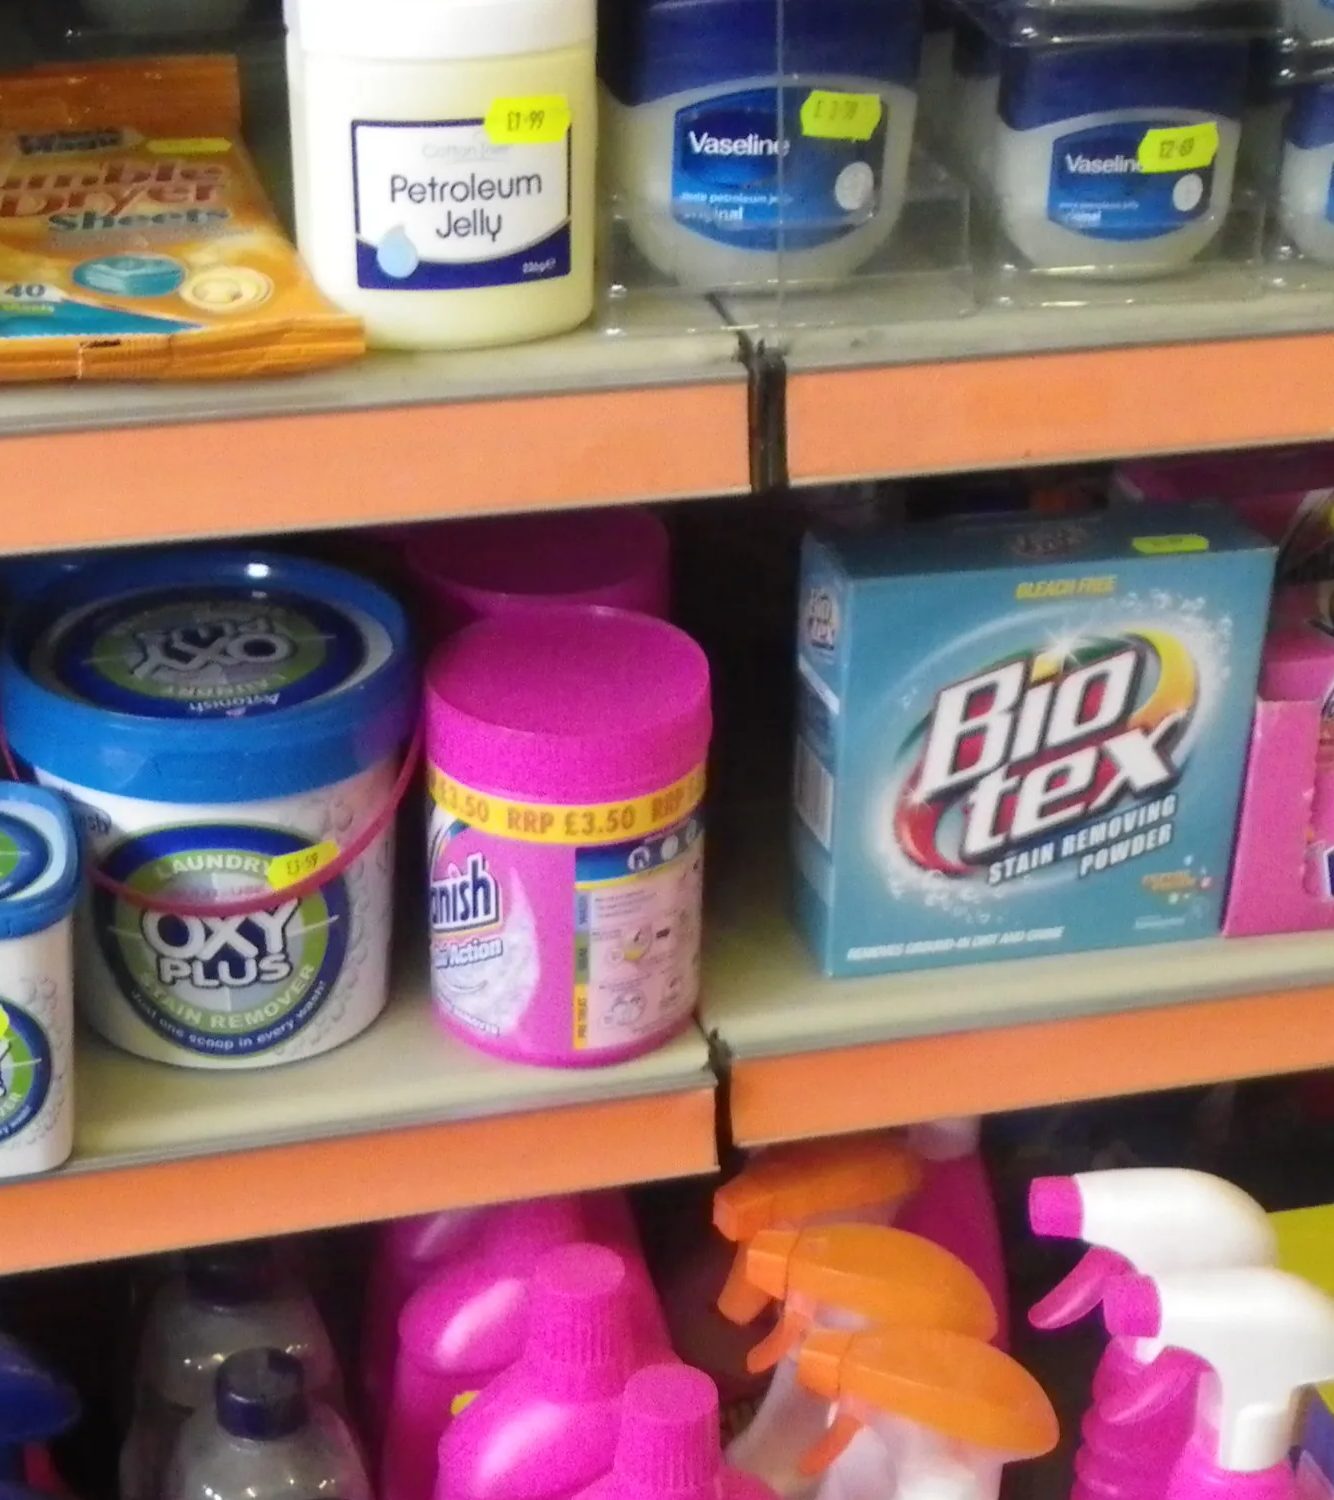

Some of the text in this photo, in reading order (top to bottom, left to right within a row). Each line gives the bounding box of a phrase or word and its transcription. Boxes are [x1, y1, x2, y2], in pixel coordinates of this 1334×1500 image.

[688, 131, 791, 157] Vaseline
[390, 172, 542, 204] Petroleum
[436, 208, 502, 242] Jelly
[5, 283, 46, 298] 40
[1015, 576, 1118, 599] BLEACH FREE
[917, 648, 1137, 799] Bio
[965, 714, 1183, 859] tex
[507, 807, 636, 837] RRP £3.50
[987, 794, 1177, 886] STAIN REMOVING
[1078, 823, 1174, 878] POWDER
[142, 900, 299, 960] OXY
[157, 954, 293, 988] PLUS
[210, 963, 316, 1029] REMOVER
[257, 1020, 295, 1044] every
